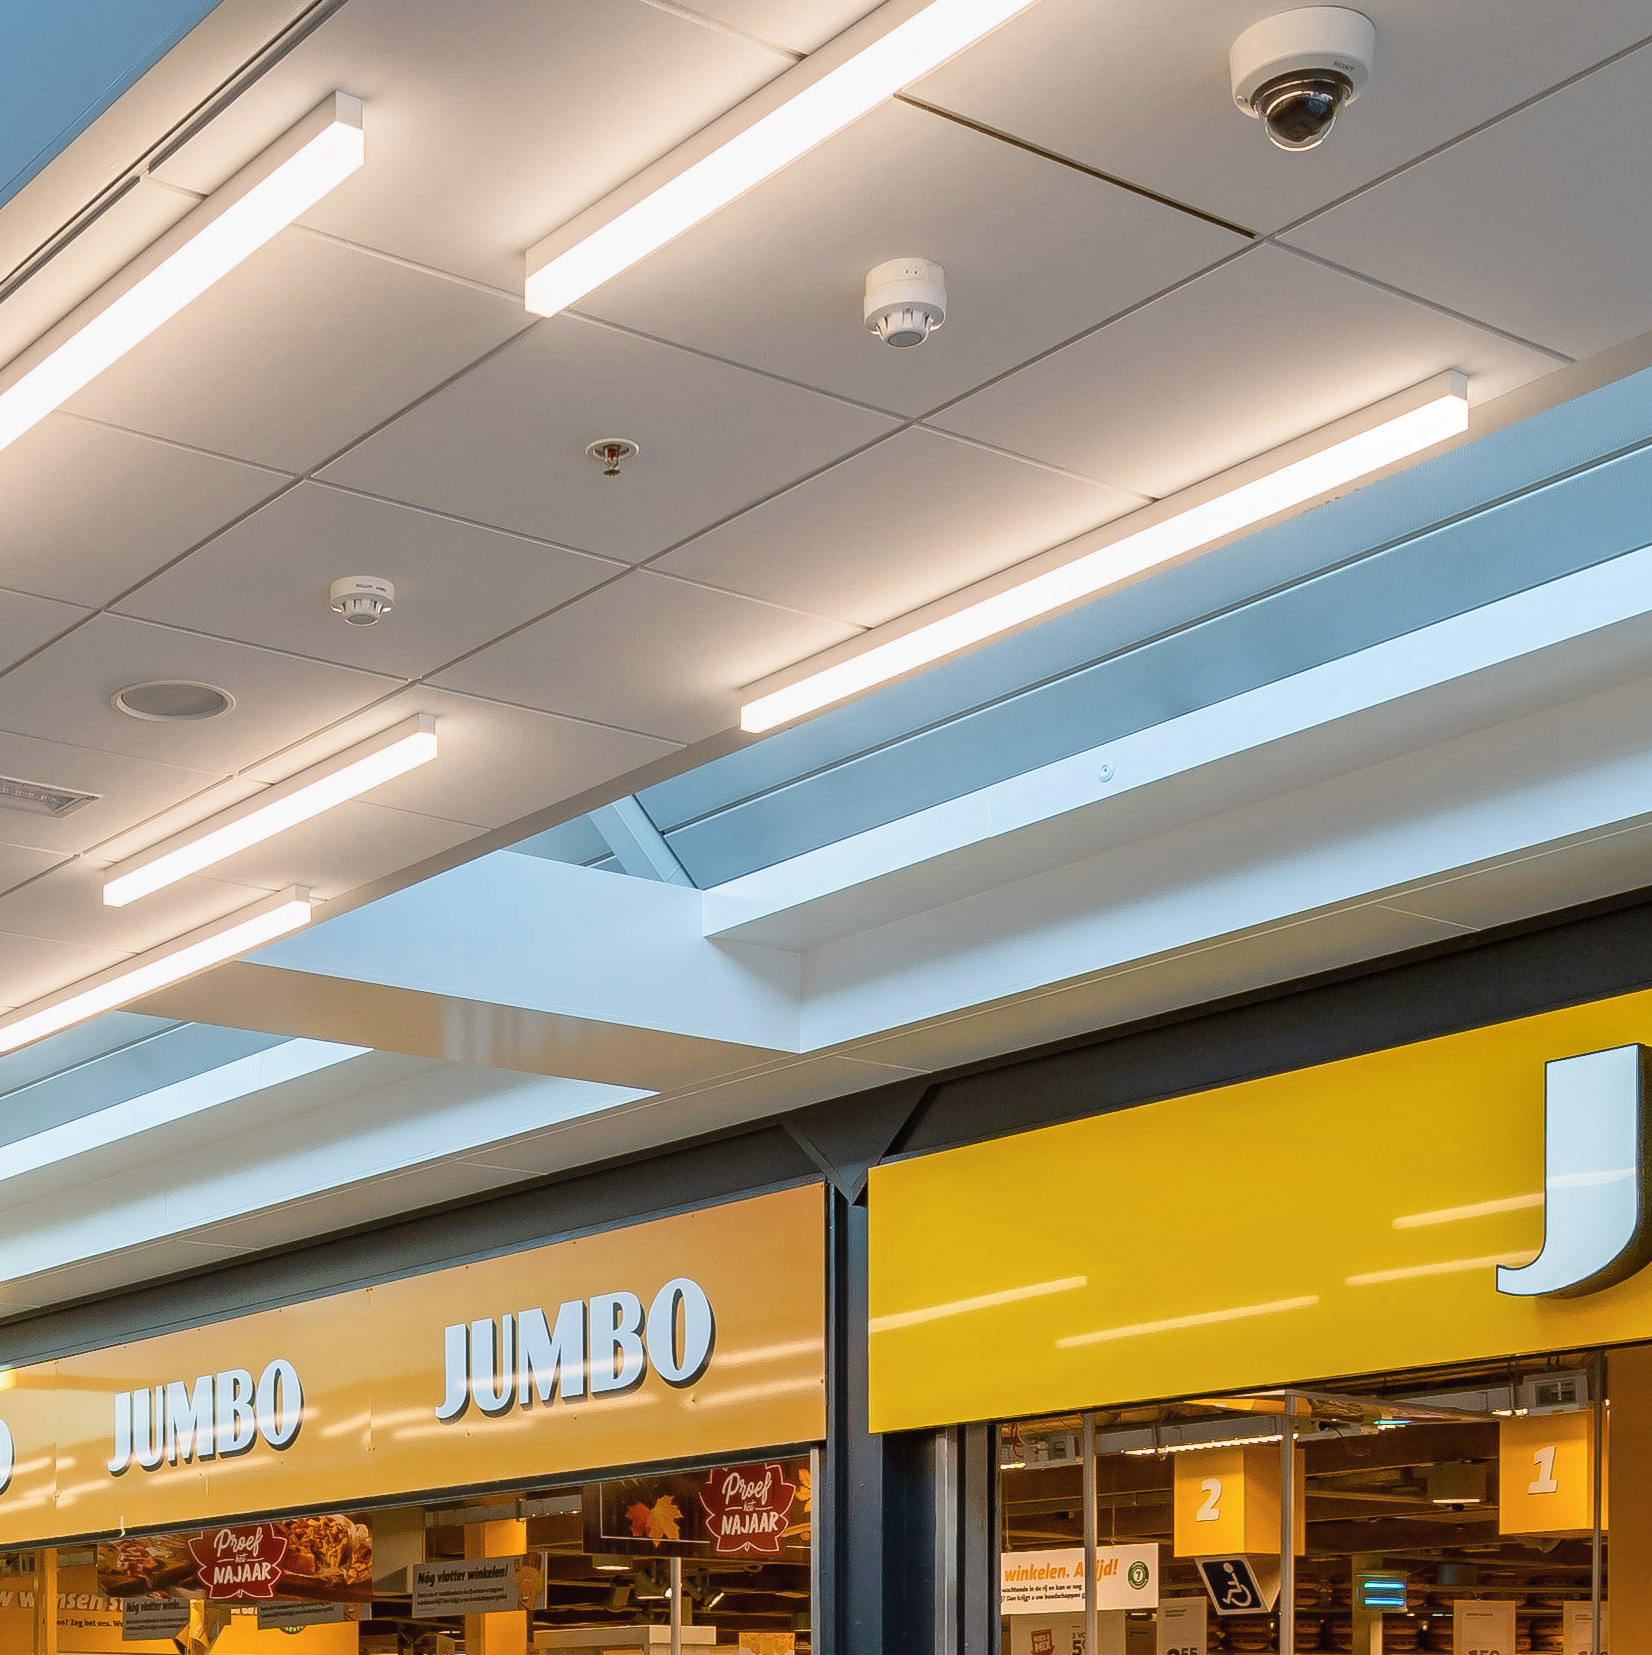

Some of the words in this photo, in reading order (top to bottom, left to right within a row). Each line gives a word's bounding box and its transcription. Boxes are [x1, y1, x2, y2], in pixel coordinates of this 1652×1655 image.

[435, 1277, 716, 1421] JUMBO
[107, 1359, 304, 1475] JUMBO
[1528, 1446, 1557, 1496] 1
[721, 1472, 773, 1500] Proef
[1196, 1478, 1223, 1522] 2
[720, 1511, 779, 1536] NAJAAR
[213, 1527, 263, 1558] Proef
[214, 1562, 272, 1585] NAJAAR
[418, 1570, 435, 1587] Nóg
[437, 1570, 466, 1582] vlotter
[467, 1564, 508, 1580] winkelen!
[1005, 1562, 1069, 1581] winkelen.
[1074, 1559, 1119, 1582] Aijd!
[19, 1587, 104, 1611] wnsen
